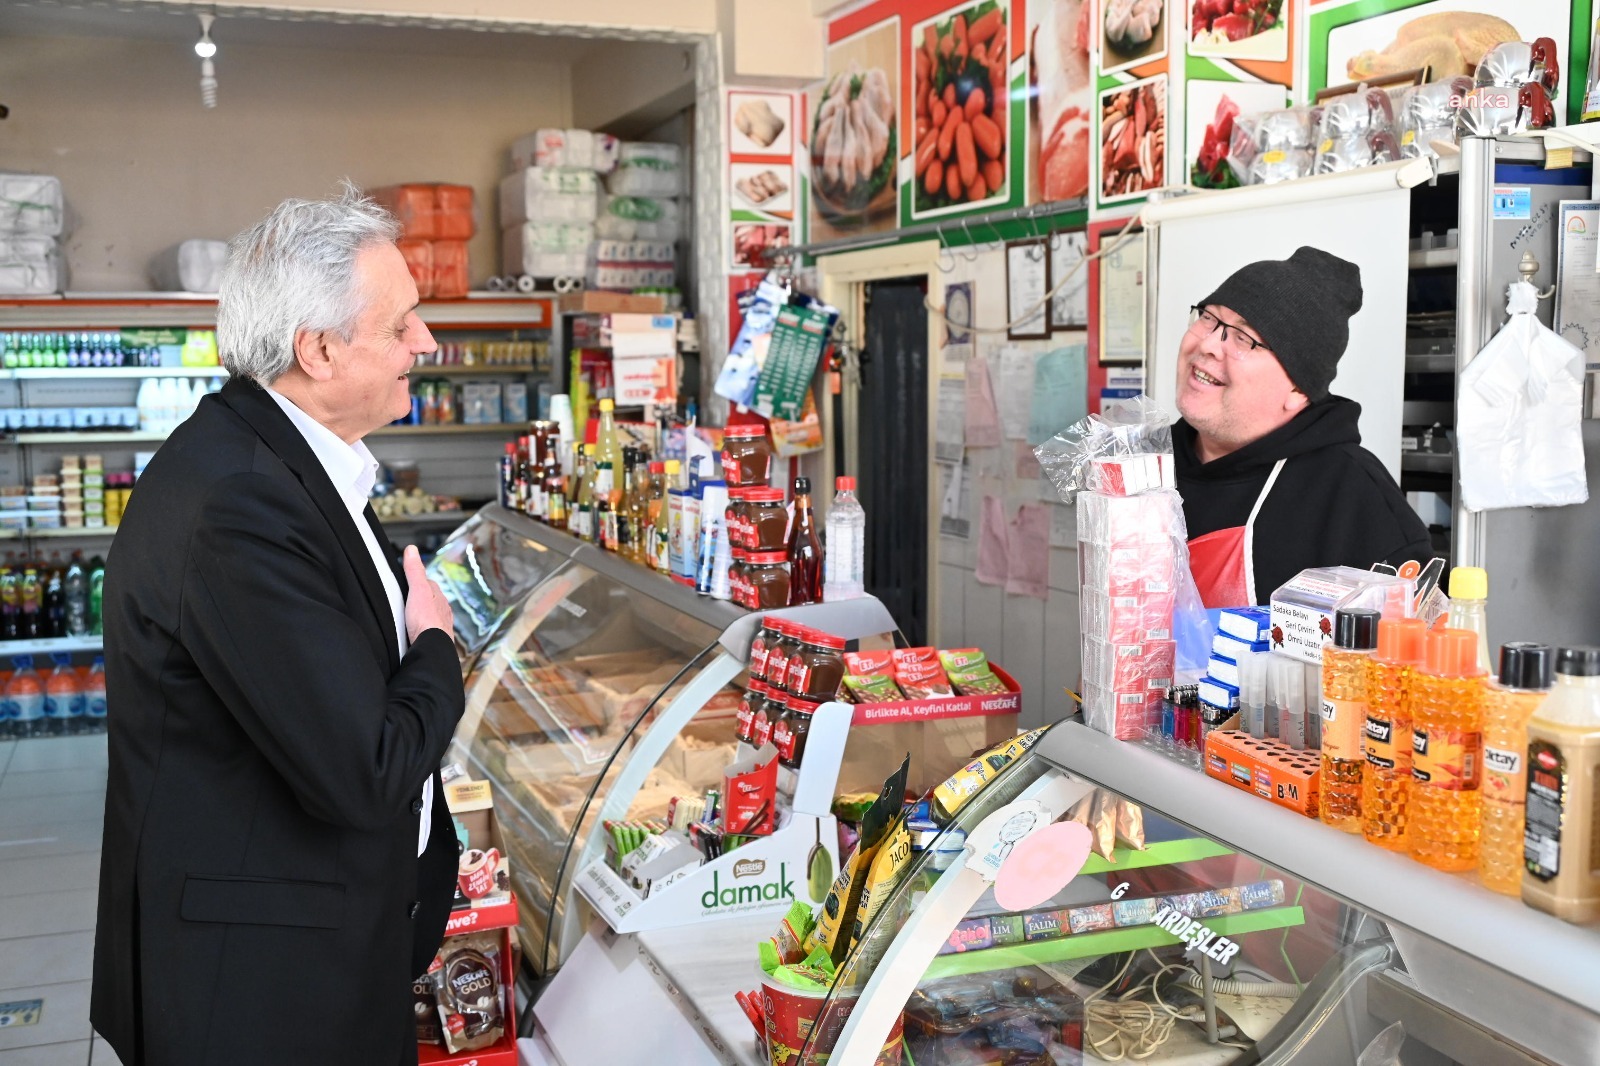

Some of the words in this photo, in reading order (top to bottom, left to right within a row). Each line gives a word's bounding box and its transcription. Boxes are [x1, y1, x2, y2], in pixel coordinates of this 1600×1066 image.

[1273, 605, 1292, 616] Sadaka
[865, 704, 899, 719] Birlikte
[901, 703, 912, 717] Al,
[914, 702, 944, 716] Keyfini
[946, 702, 971, 712] Katla!
[889, 842, 909, 872] JACO
[702, 862, 794, 908] damak
[993, 925, 1011, 935] LIM
[1028, 918, 1057, 932] FALIM
[1110, 882, 1130, 900] G
[1150, 906, 1240, 966] ARDEŞLER
[461, 977, 491, 995] GOLD
